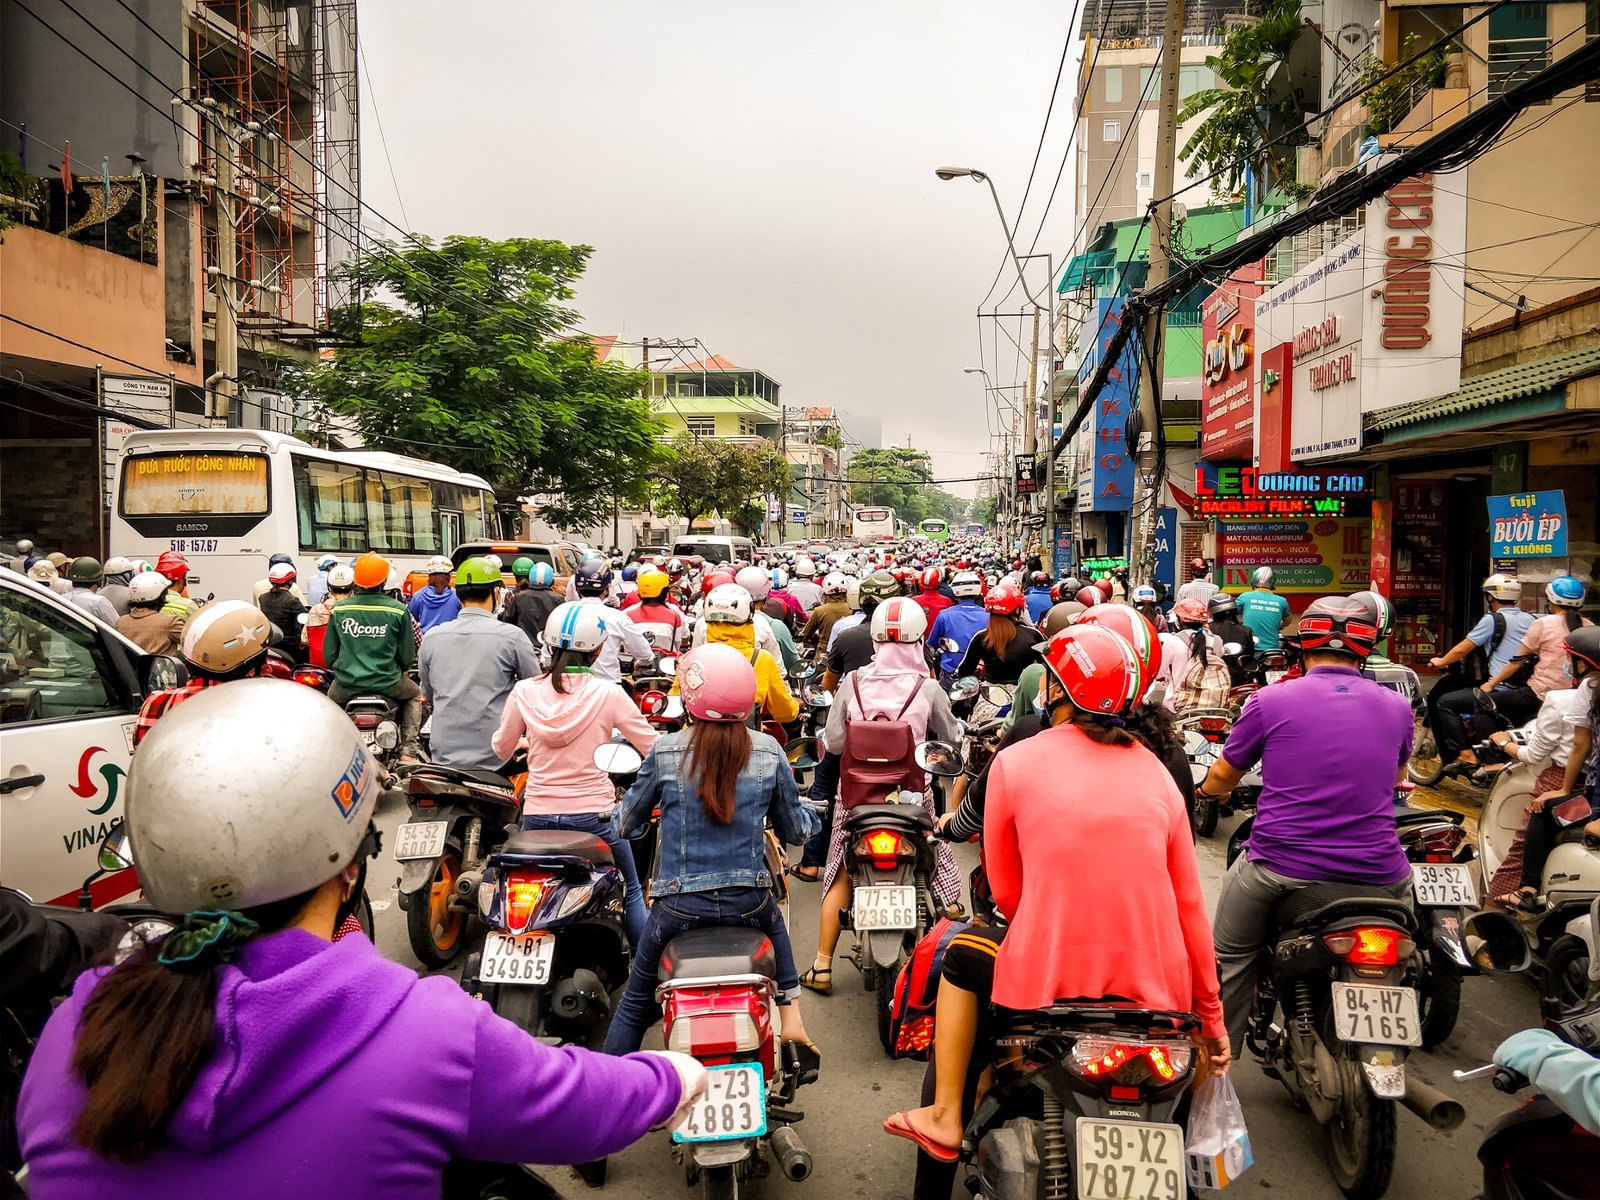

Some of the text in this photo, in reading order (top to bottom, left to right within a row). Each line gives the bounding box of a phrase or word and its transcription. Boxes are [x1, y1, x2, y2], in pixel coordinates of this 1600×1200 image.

[1371, 235, 1433, 350] QUẢNG
[139, 454, 256, 474] ĐƯA RƯỚC CÔNG NHÂN
[1500, 454, 1518, 473] 47
[1326, 473, 1364, 492] CÁO
[1510, 494, 1536, 508] fuji
[176, 523, 208, 532] SAMCO
[1494, 509, 1535, 543] BƯỞI
[170, 539, 218, 552] 51B-157.67
[1503, 543, 1553, 554] 3 KHÔNG
[1226, 568, 1249, 585] IN
[342, 618, 388, 638] Ricons
[63, 815, 125, 854] VINAS
[404, 824, 439, 842] 54-S2
[400, 840, 438, 857] 6007
[1420, 866, 1463, 885] 59-S2
[864, 888, 906, 907] 77-E1
[1419, 885, 1473, 904] 317.54
[859, 907, 912, 926] 236.66
[496, 934, 542, 956] 70-B1
[485, 958, 545, 980] 349.65
[1346, 988, 1402, 1012] 84-H7
[1348, 1014, 1408, 1041] 7165
[1109, 1110, 1141, 1118] HONDA
[1093, 1125, 1167, 1164] 59-X2
[1086, 1162, 1178, 1200] 787.29
